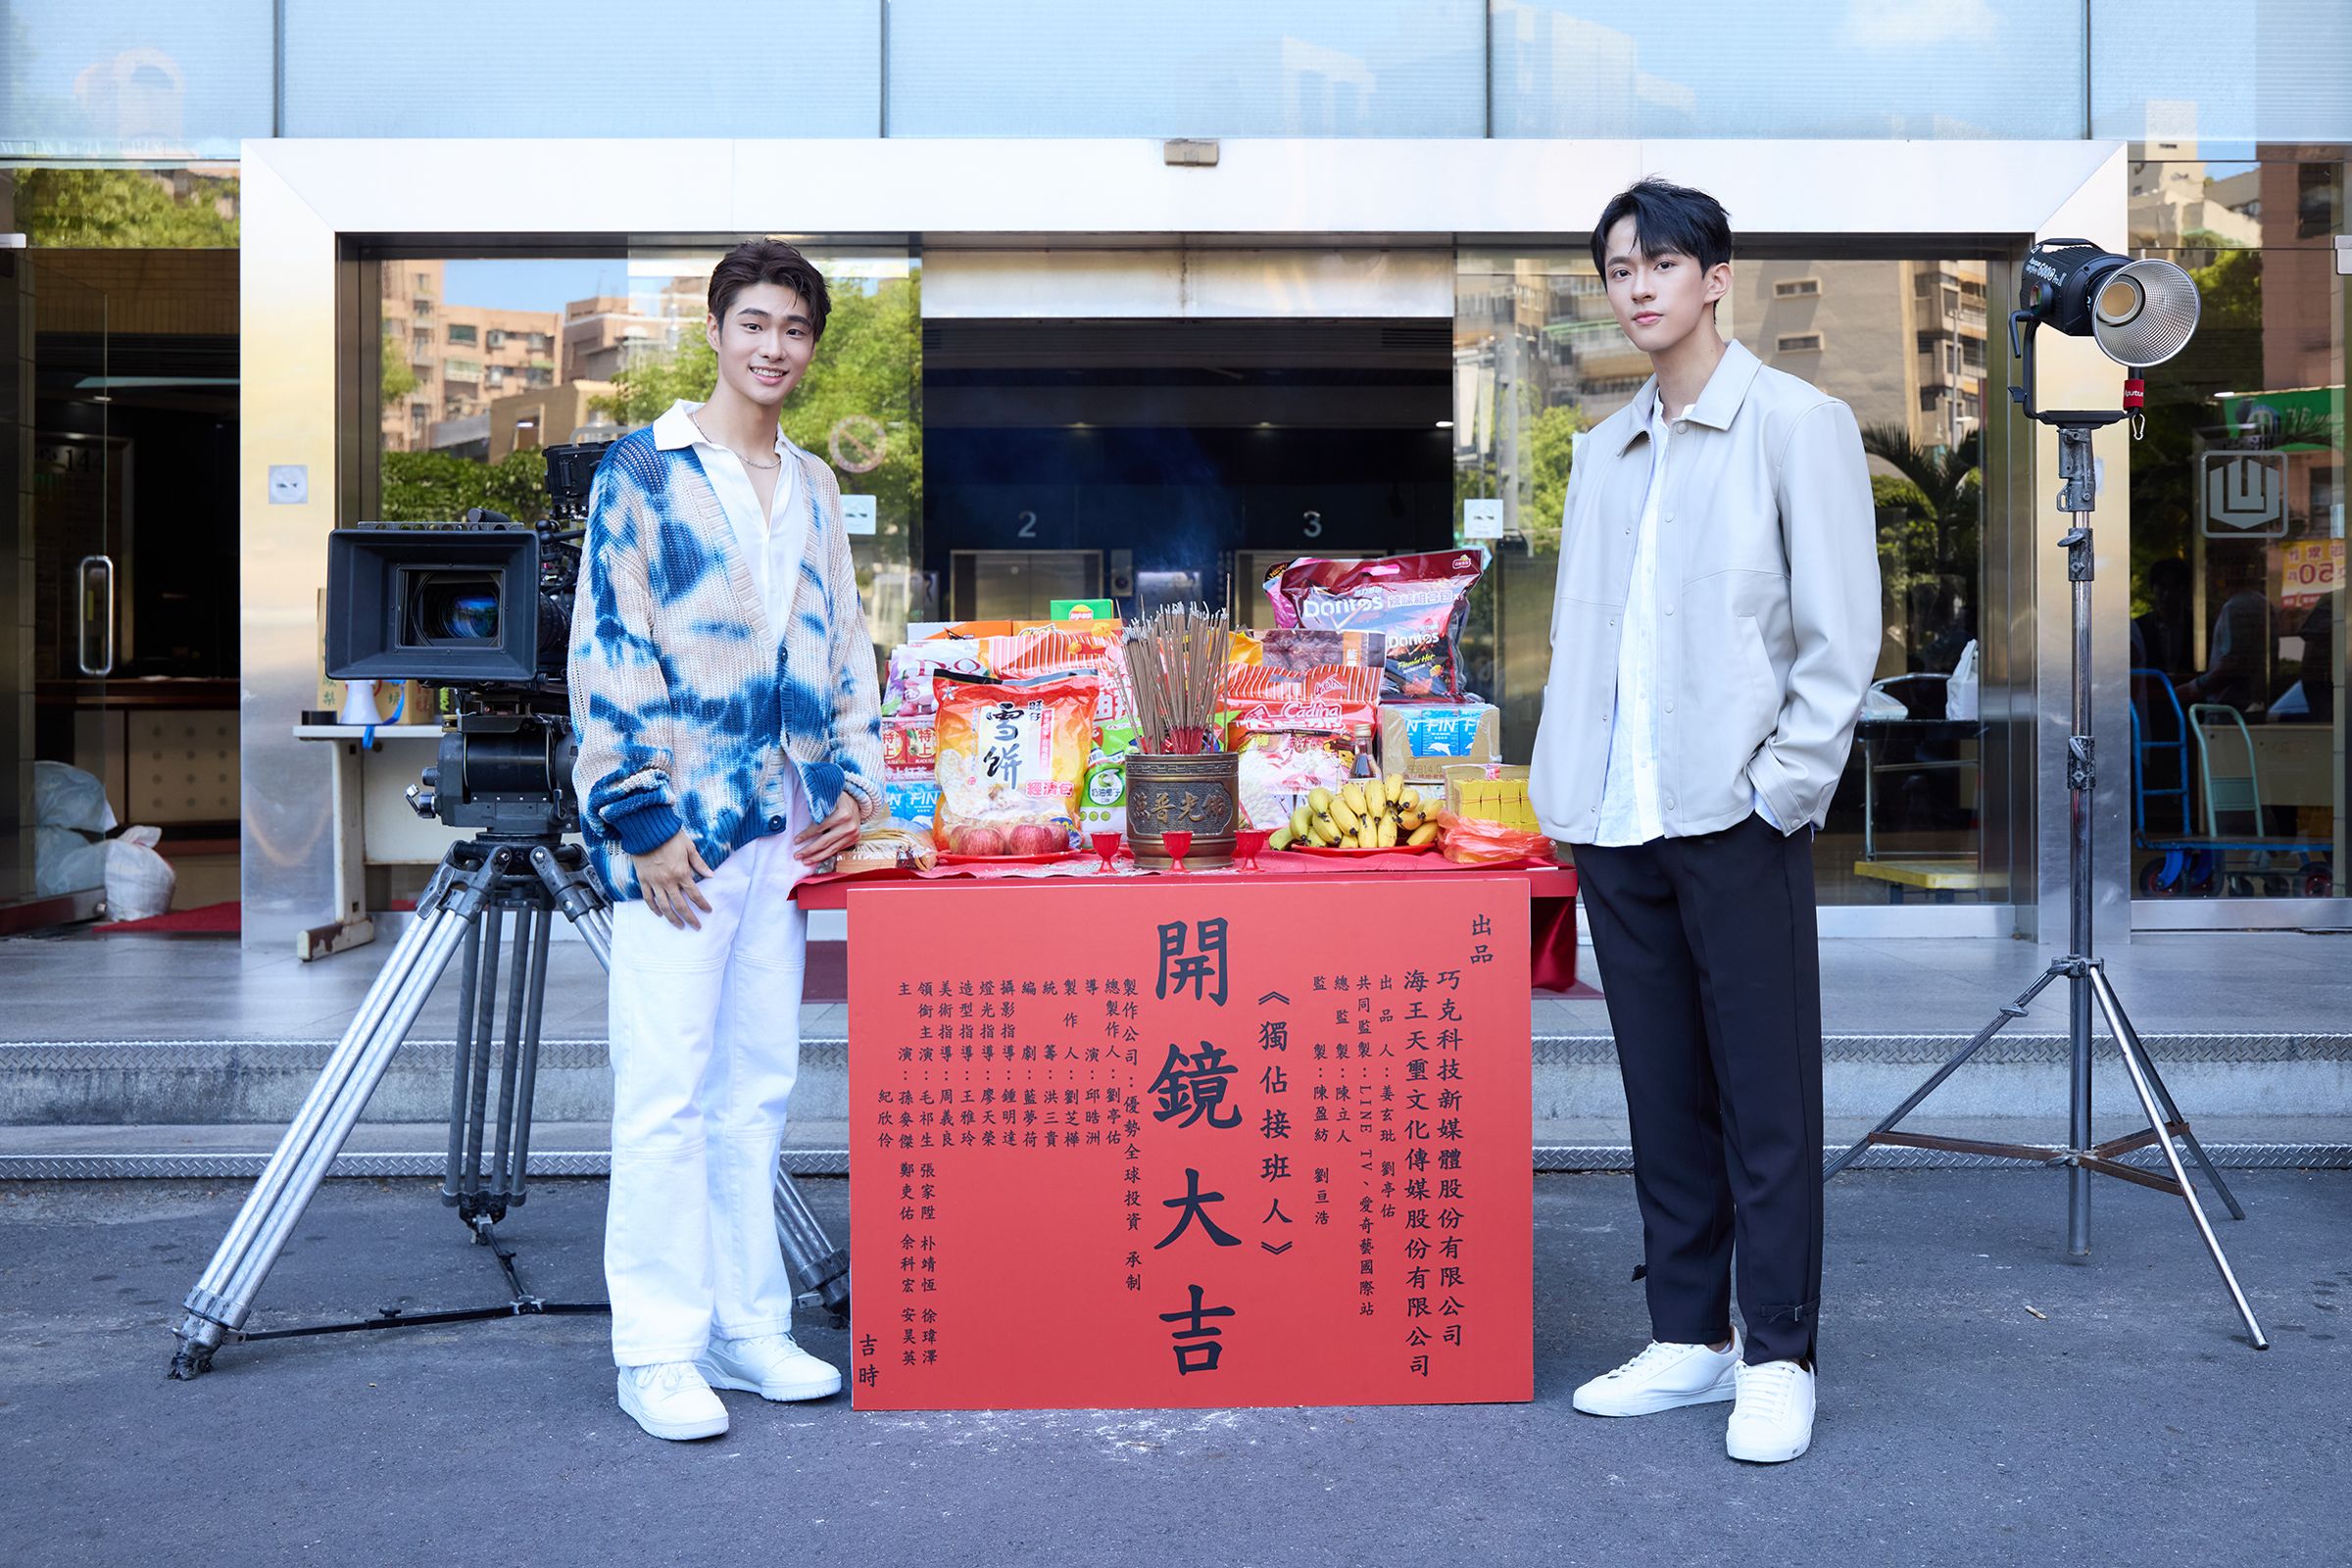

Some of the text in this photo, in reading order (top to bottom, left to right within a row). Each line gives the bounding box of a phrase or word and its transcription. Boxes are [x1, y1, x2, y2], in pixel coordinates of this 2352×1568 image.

[1017, 511, 1037, 538] 2
[1302, 511, 1322, 538] 3
[1302, 596, 1384, 618] Doritos
[1388, 632, 1441, 648] Doritos
[1028, 700, 1043, 721] 旺仔
[1283, 703, 1340, 718] Cadina
[1426, 718, 1456, 732] FIN
[918, 728, 932, 757] 特上
[983, 702, 1026, 789] 雪餅
[910, 791, 938, 806] FIN
[1027, 781, 1073, 796] 經濟包
[1471, 914, 1493, 963] 出品
[878, 1090, 893, 1147] 紀欣伶
[1258, 992, 1293, 1254] 《獨佔接班人》
[1148, 917, 1243, 1376] 開鏡大吉
[1437, 970, 1464, 1347] 巧克科技新媒體股份有限公司
[921, 1164, 934, 1219] 張家陞
[1381, 1161, 1396, 1217] 劉亭佑
[1404, 970, 1432, 1377] 海王天璽文化傳媒股份有限公司
[902, 1235, 914, 1292] 余科宏
[1126, 1251, 1141, 1291] 承制
[859, 1334, 878, 1387] 吉時
[922, 1309, 937, 1364] 徐瑋澤
